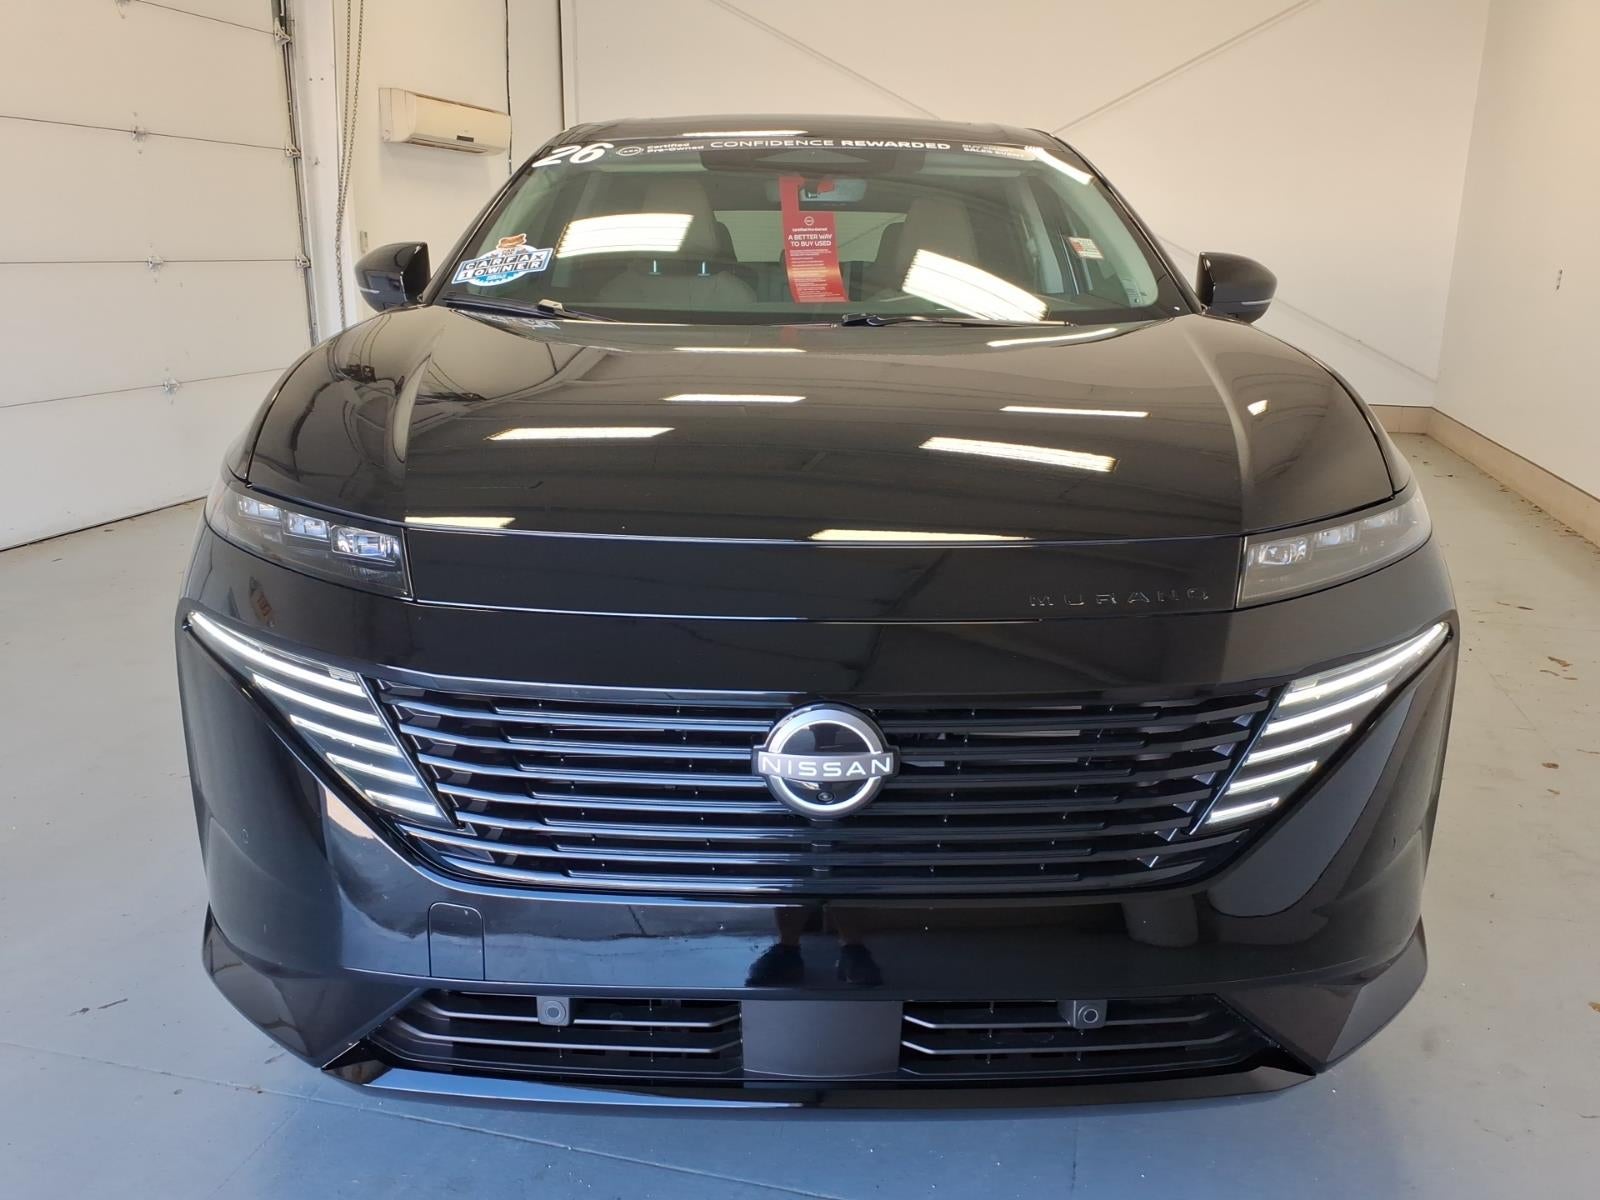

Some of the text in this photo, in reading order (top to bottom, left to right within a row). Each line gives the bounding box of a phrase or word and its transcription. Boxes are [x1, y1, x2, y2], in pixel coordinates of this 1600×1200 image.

[710, 140, 951, 150] CONFIDENCE REWARDED
[532, 143, 614, 167] 26
[465, 251, 544, 270] CARFAX
[474, 261, 540, 276] OWNER
[762, 756, 891, 777] NISSAN
